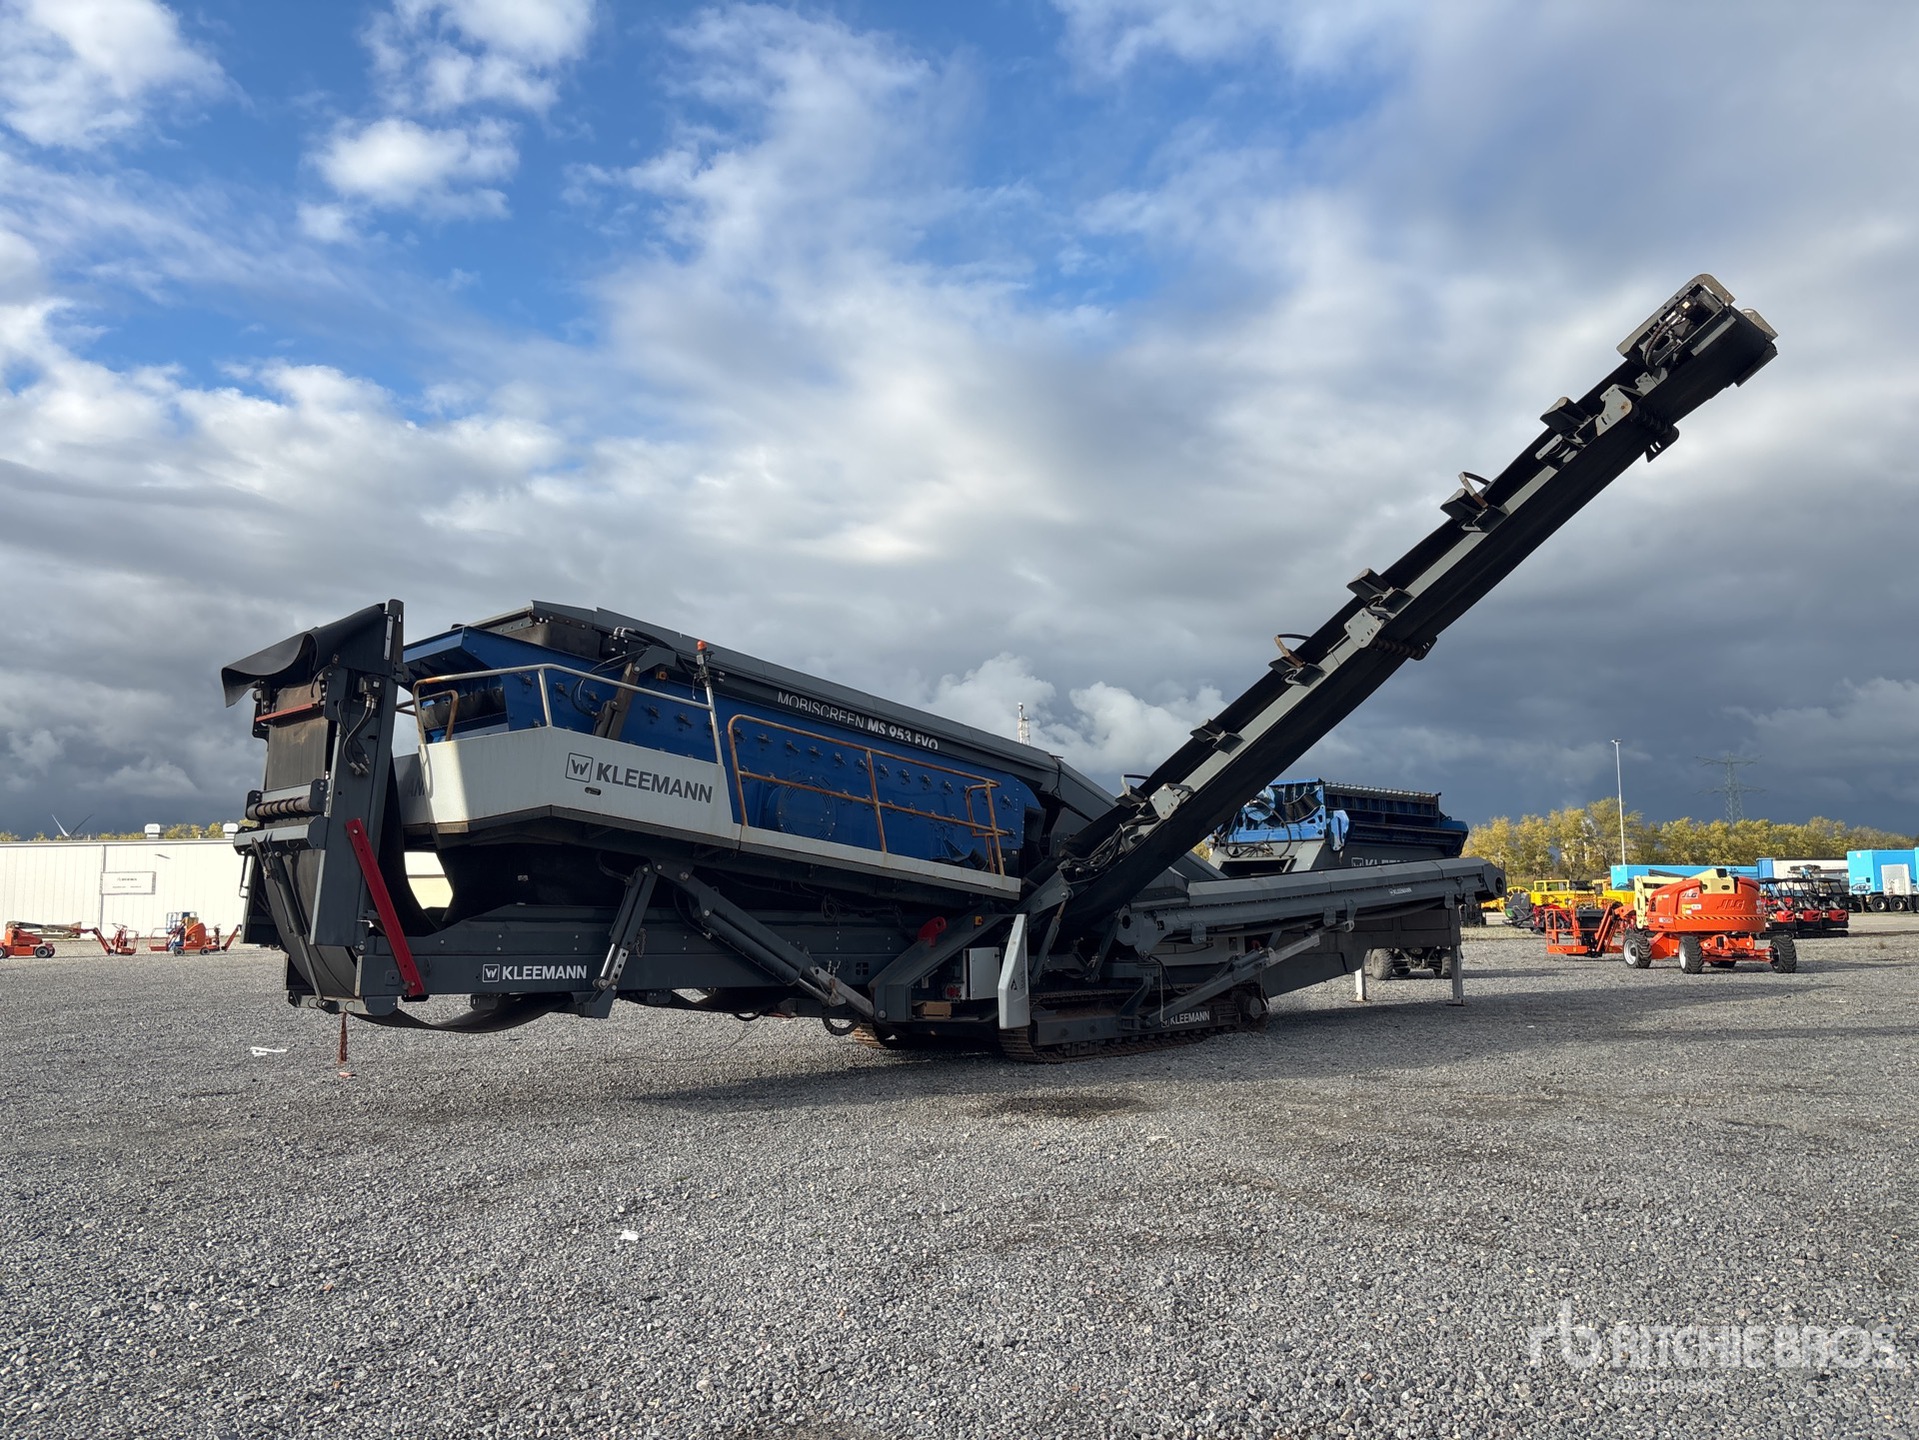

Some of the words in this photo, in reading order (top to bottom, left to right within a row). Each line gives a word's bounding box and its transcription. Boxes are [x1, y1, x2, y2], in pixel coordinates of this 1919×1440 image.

[777, 691, 865, 729] MOBISCREEN
[867, 717, 886, 735] MS
[889, 724, 911, 743] 953
[596, 762, 713, 804] KLEEMANN
[502, 965, 587, 980] KLEEMANN
[1170, 1010, 1210, 1025] KLEEMANN
